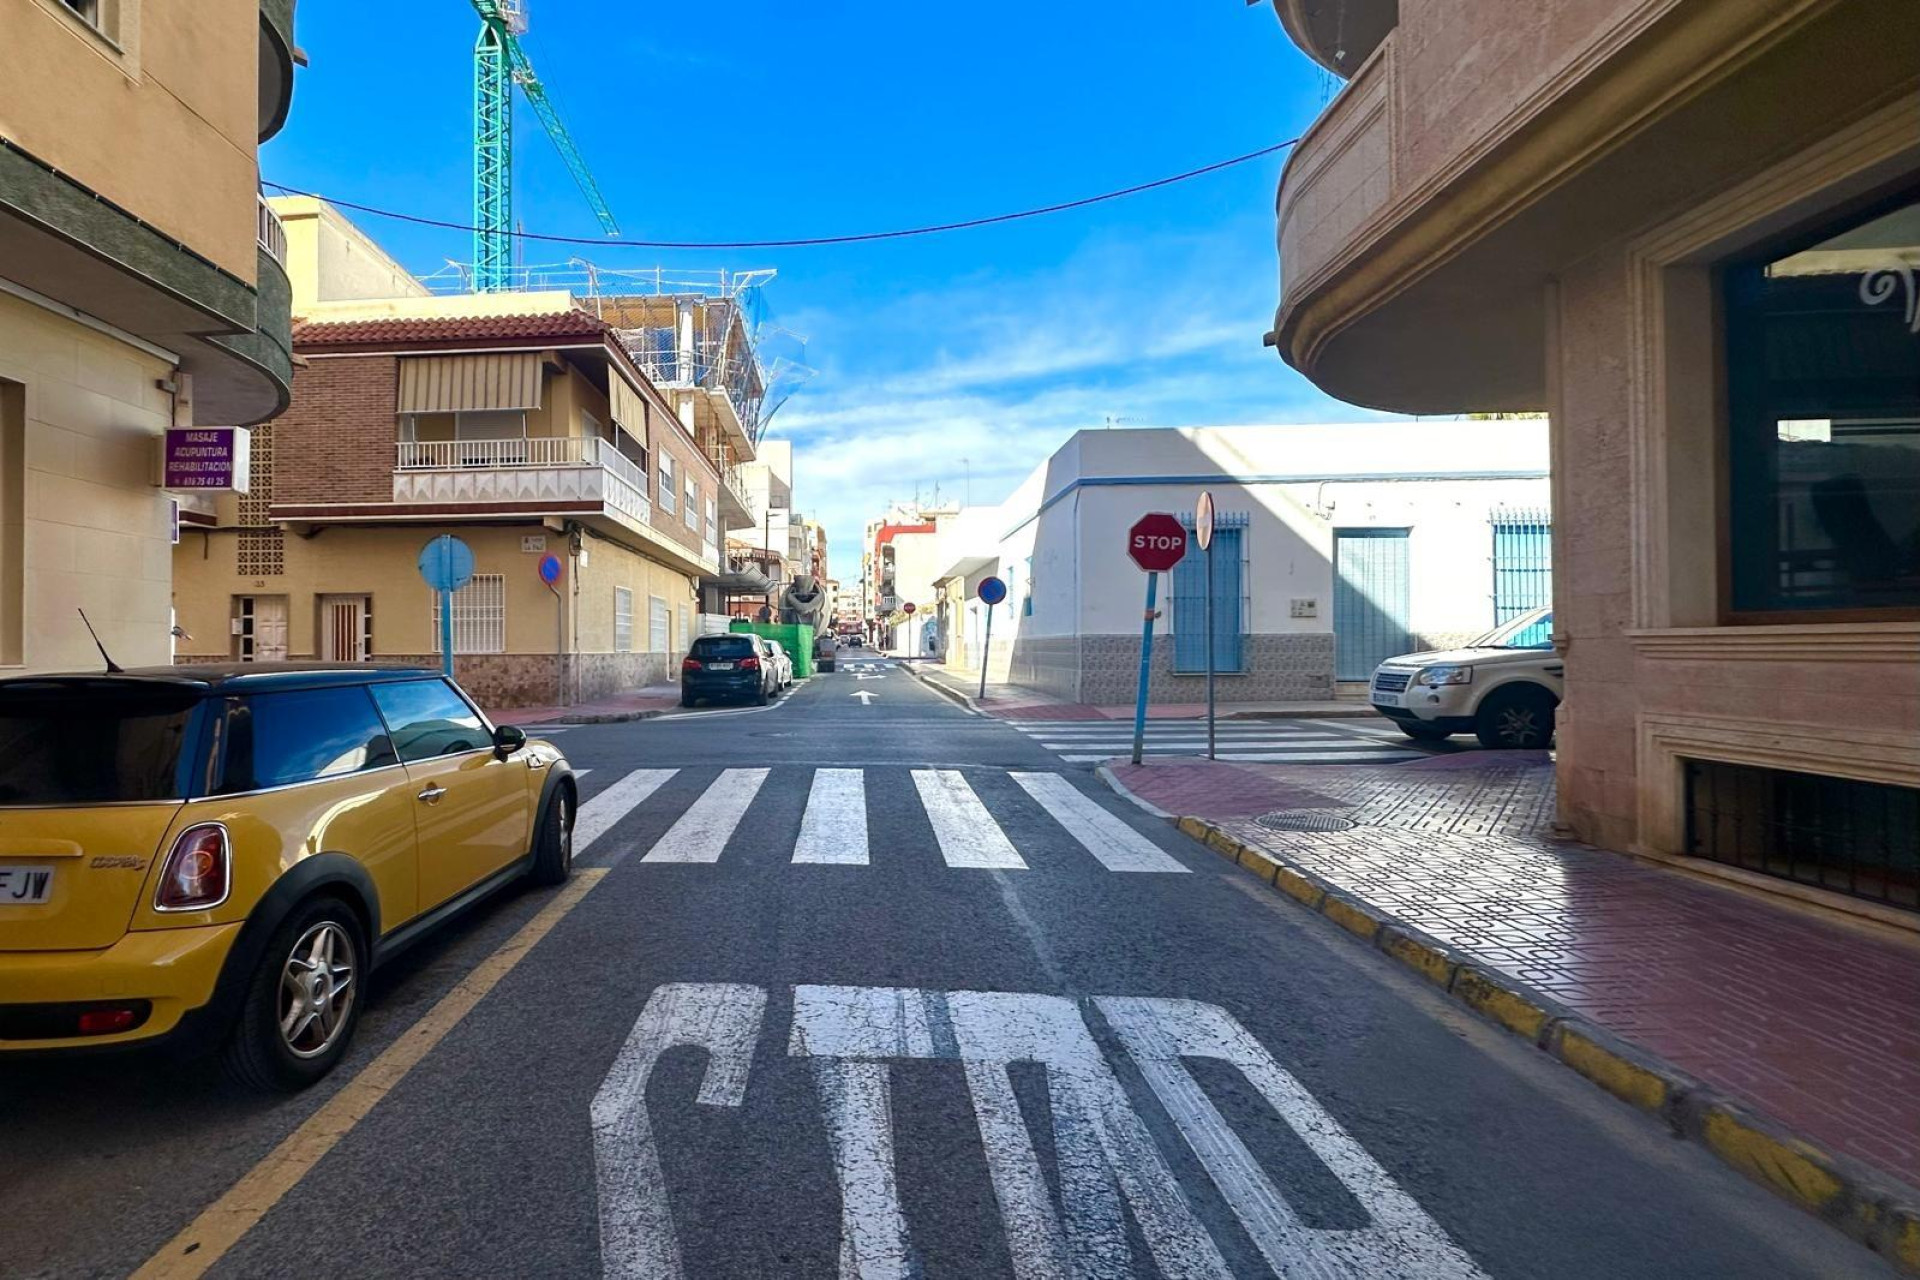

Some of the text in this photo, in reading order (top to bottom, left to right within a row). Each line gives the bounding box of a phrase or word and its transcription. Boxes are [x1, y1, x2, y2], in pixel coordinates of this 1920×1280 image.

[186, 431, 218, 442] MASAJE
[174, 447, 228, 457] ACUPUNTURA
[168, 461, 232, 472] REHABILITACION
[213, 477, 225, 486] 25
[1134, 535, 1182, 550] STOP
